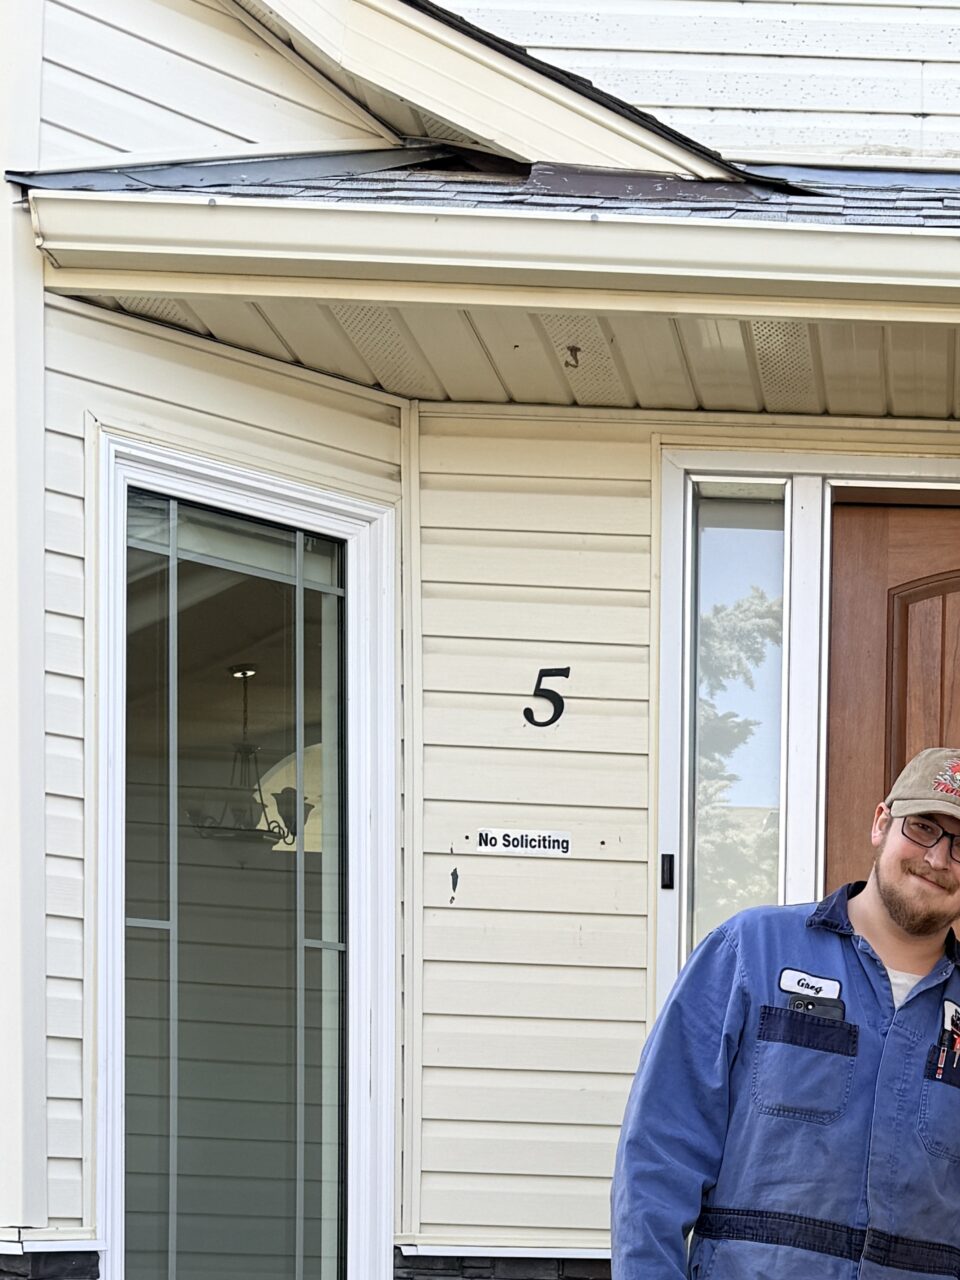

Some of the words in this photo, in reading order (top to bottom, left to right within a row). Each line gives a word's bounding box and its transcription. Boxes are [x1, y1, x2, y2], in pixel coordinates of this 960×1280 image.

[523, 666, 571, 728] 5
[478, 832, 498, 847] No
[502, 833, 570, 854] Soliciting
[797, 977, 824, 995] Greg
